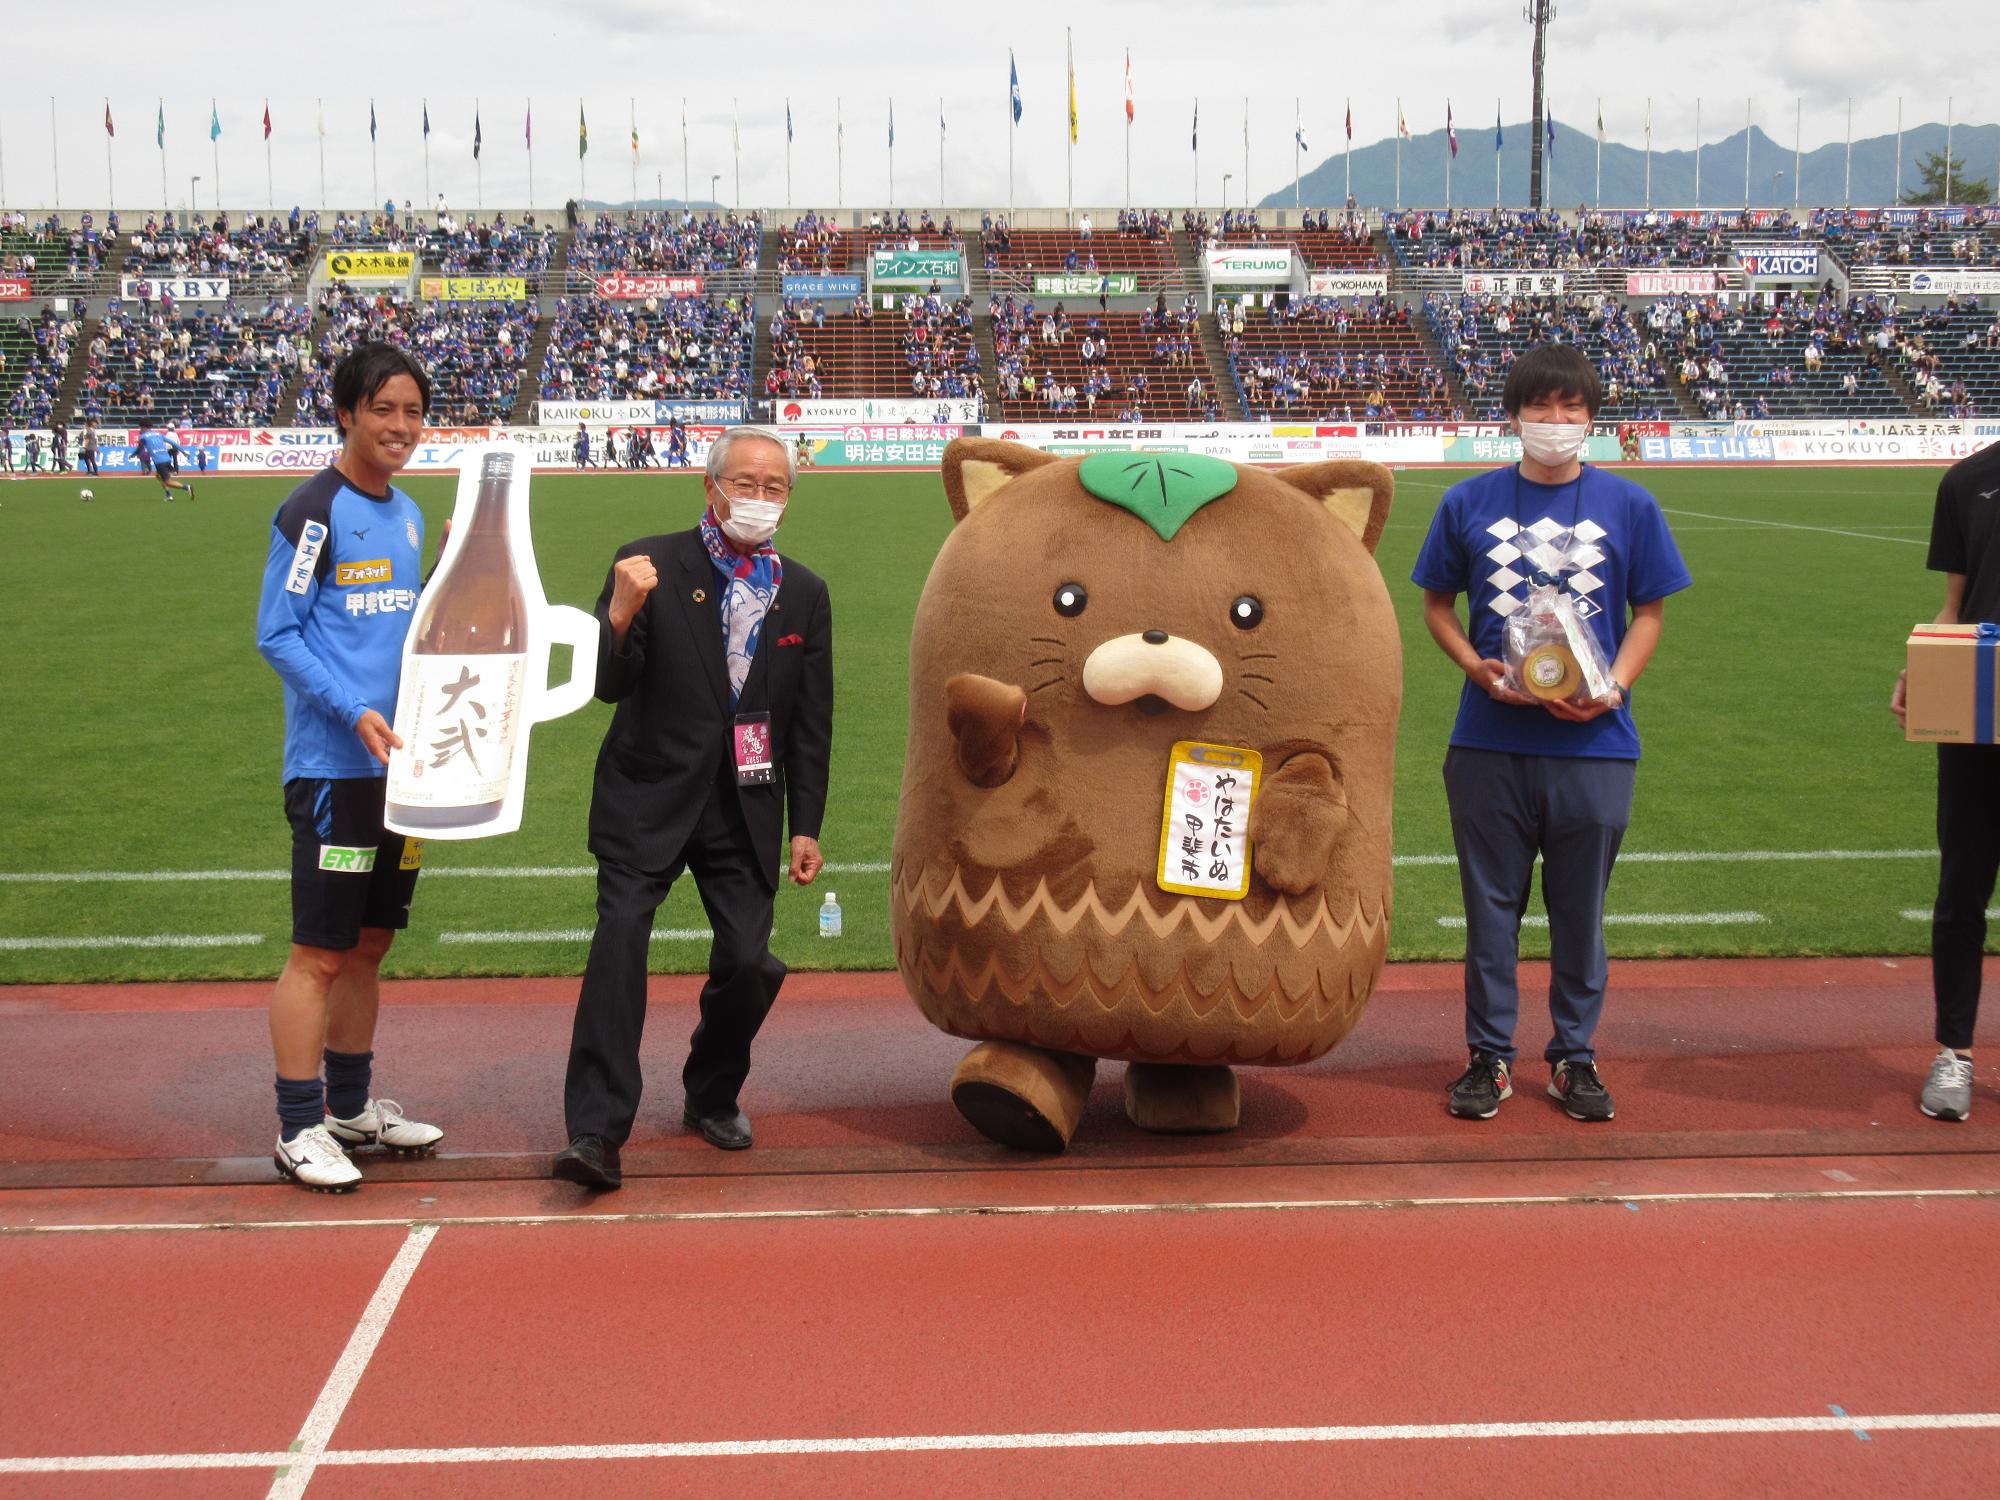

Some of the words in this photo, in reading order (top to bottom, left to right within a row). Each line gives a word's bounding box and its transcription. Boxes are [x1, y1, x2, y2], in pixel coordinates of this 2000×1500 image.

[356, 256, 410, 268] 大木電機
[876, 260, 958, 276] ウインズ石和
[1224, 259, 1288, 270] TERUMO
[1757, 257, 1818, 274] KATOH
[622, 279, 697, 293] アップル車検
[786, 283, 824, 291] GRACE
[829, 283, 857, 291] WINE
[1331, 280, 1384, 290] YOKOHAMA
[1493, 276, 1557, 292] 正直堂
[629, 407, 651, 419] DX
[806, 406, 858, 416] KYOKUYO
[845, 443, 944, 463] 明治安田生
[1645, 439, 1771, 458] 日医工山梨
[1805, 442, 1901, 454] KYOKUYO
[233, 453, 264, 463] NNS
[266, 450, 333, 467] CCNet
[341, 564, 388, 580] フォネット
[345, 589, 418, 616] 甲斐ゼミナ
[1208, 773, 1237, 882] やはたいぬ
[1181, 813, 1204, 882] 甲斐市
